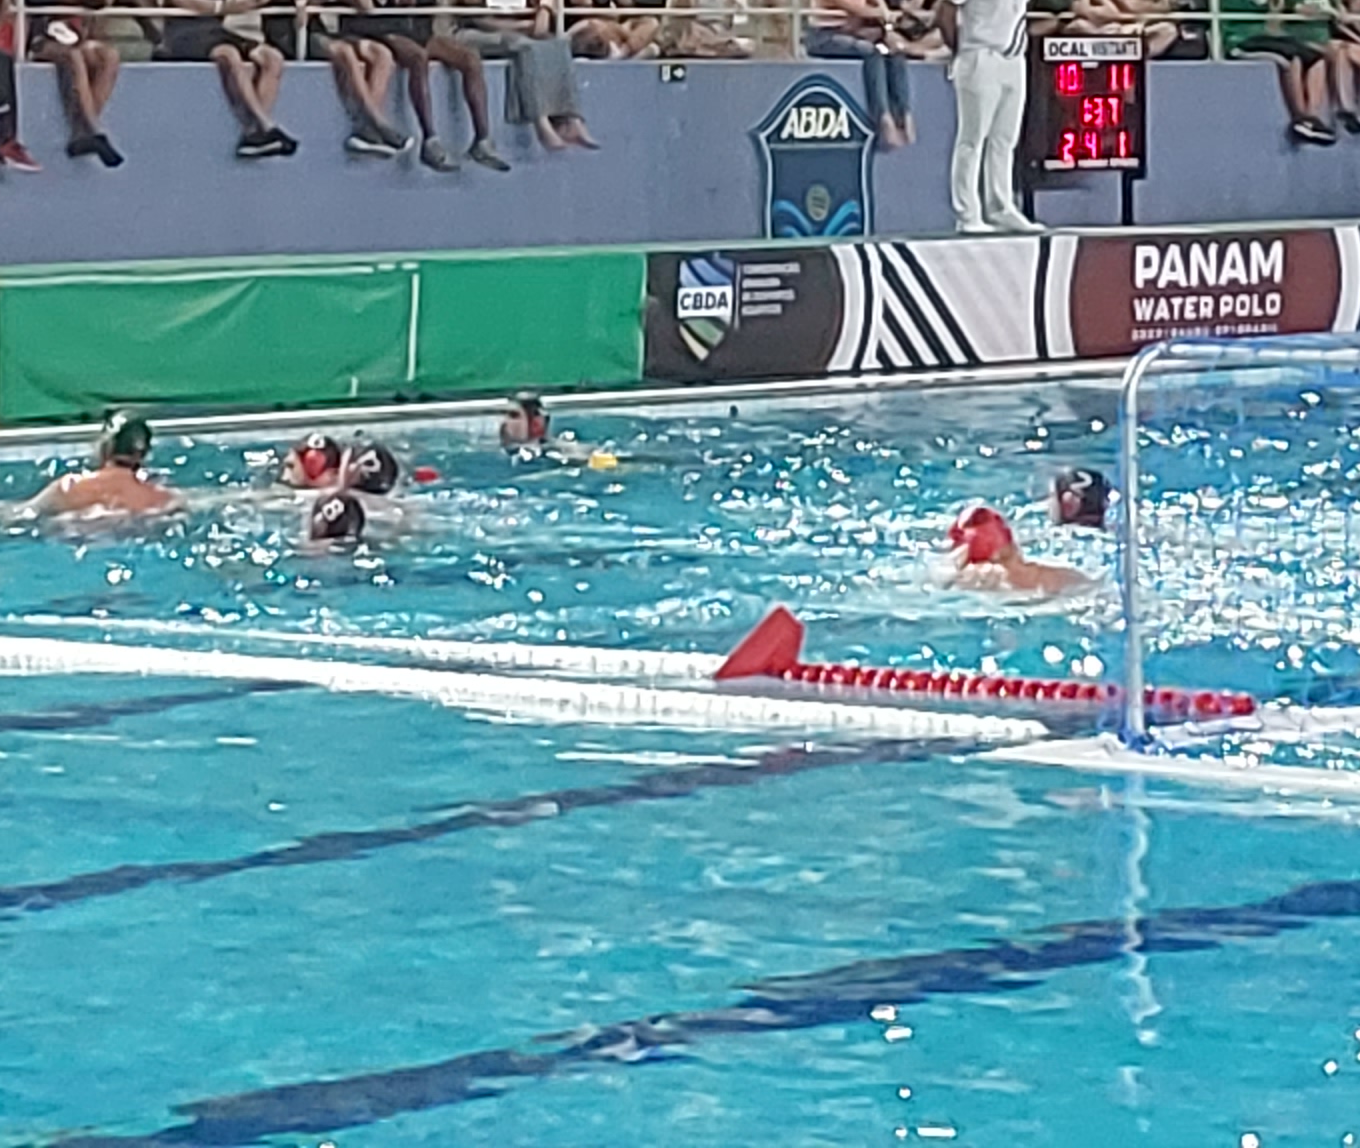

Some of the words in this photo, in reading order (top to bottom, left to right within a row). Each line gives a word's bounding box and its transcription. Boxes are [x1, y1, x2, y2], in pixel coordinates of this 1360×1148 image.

[780, 105, 851, 140] ABDA
[1134, 240, 1284, 289] PANAM
[680, 291, 728, 310] CBDA
[1132, 294, 1215, 322] WATER
[1219, 292, 1281, 318] POLO
